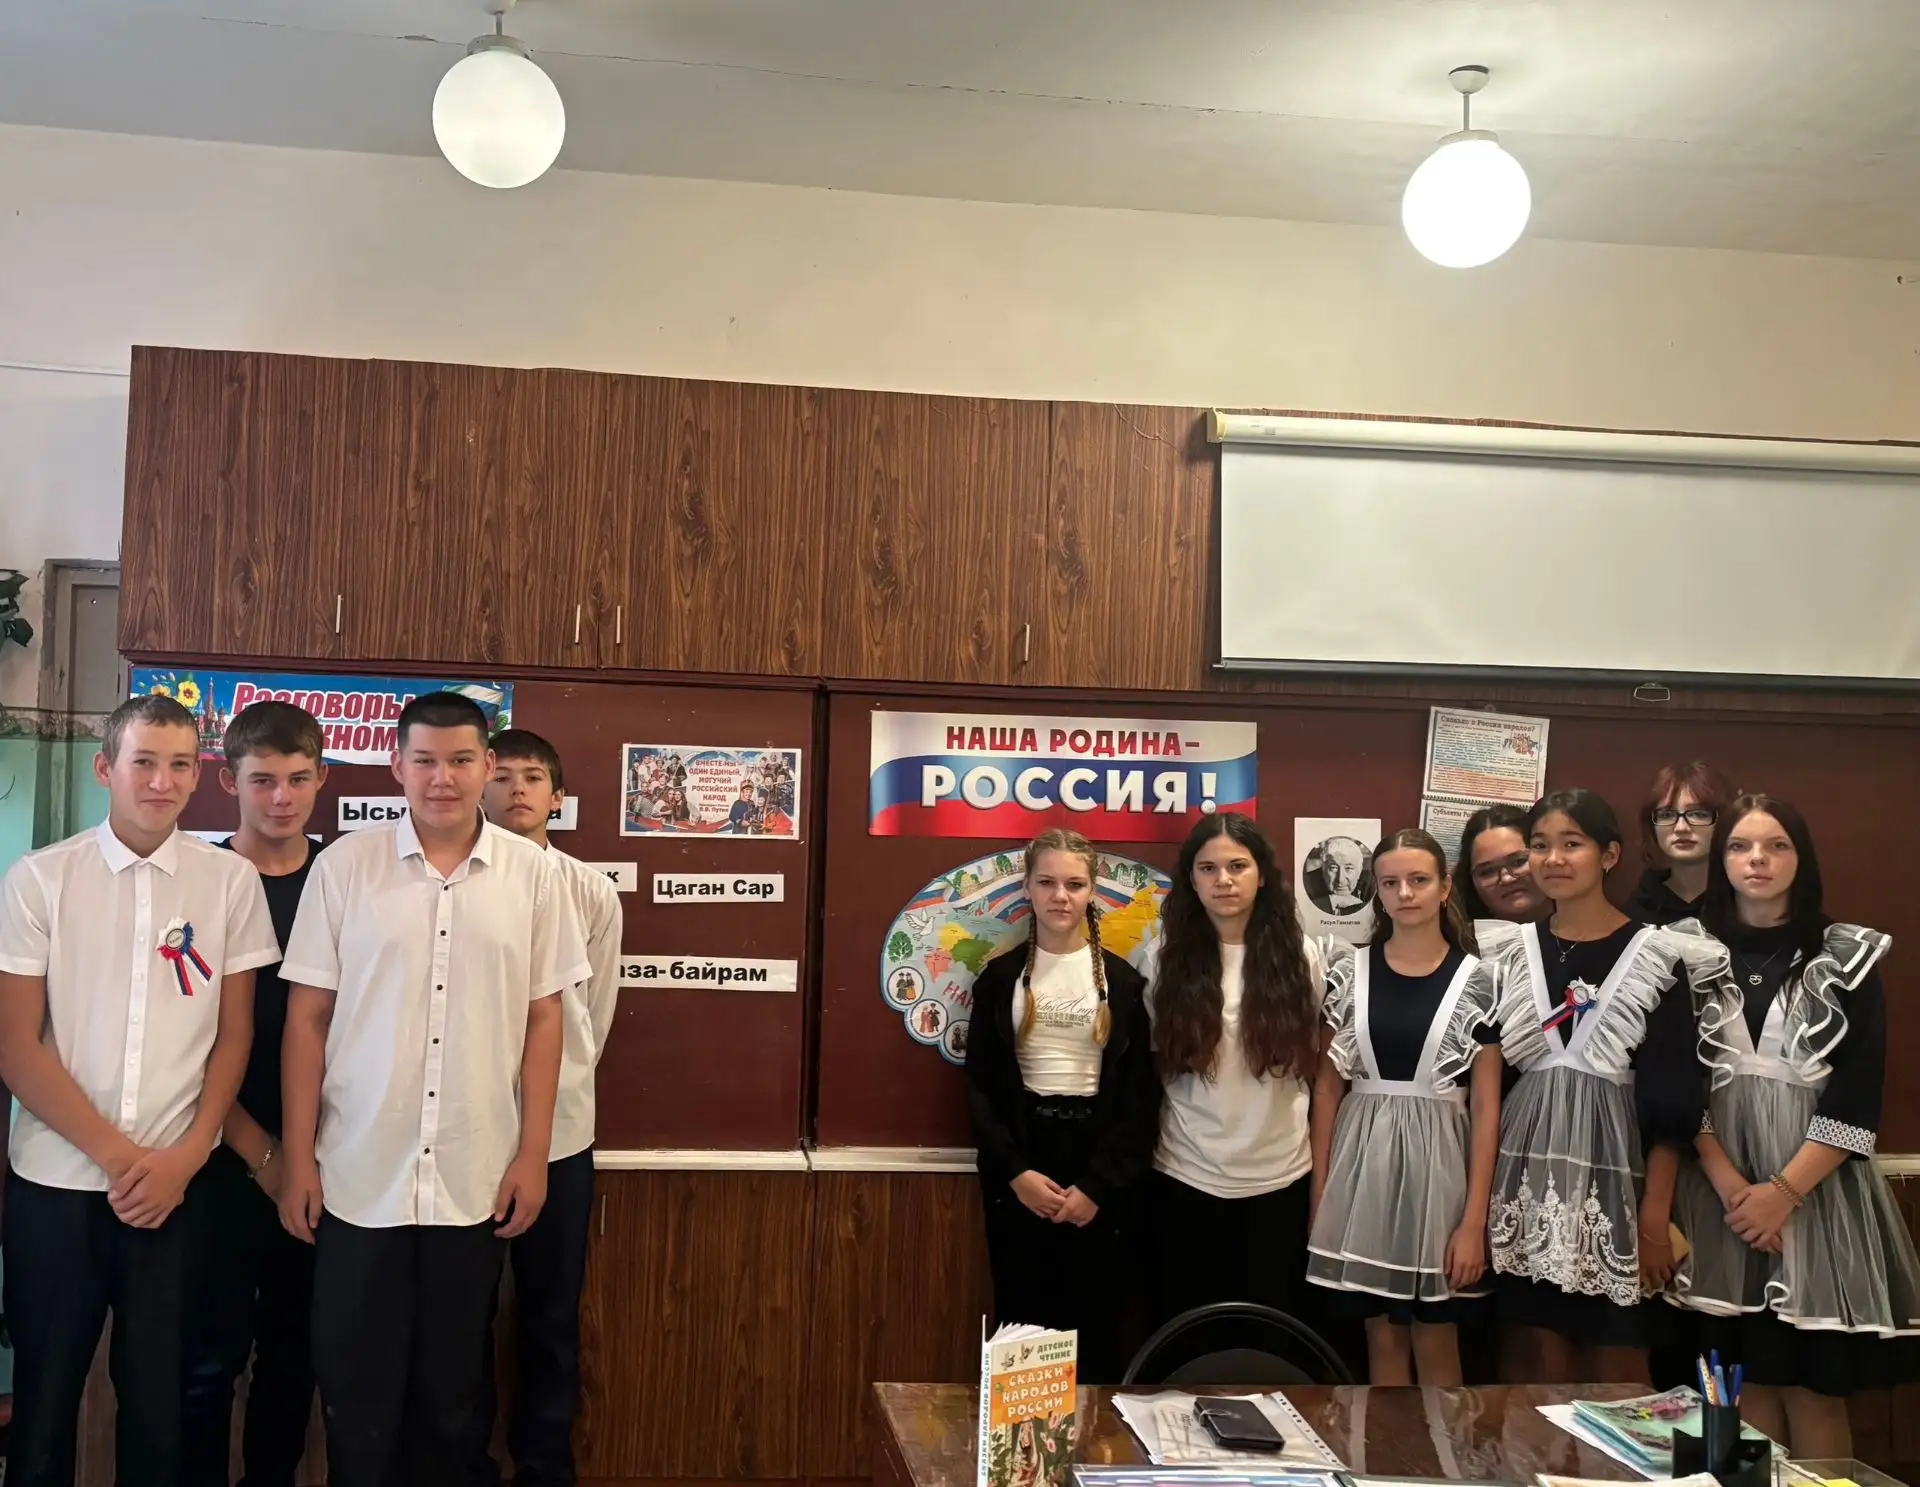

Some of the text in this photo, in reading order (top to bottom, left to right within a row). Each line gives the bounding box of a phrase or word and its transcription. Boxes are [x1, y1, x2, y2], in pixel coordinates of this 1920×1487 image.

[946, 726, 1039, 751] НАША
[691, 785, 738, 793] РОССИЙСКИЙ
[699, 776, 732, 784] МОГУЧИЙ
[702, 794, 726, 802] НАРОД
[921, 765, 1219, 815] РОССИЯ!
[343, 803, 407, 820] Ысы
[657, 879, 775, 899] Цаган Сар
[1037, 1339, 1073, 1354] ДЕТСКОЕ
[1039, 1350, 1071, 1362] ЧТЕНИЕ
[1009, 1367, 1064, 1387] СКАЗКИ
[1003, 1380, 1069, 1404] НАРОДОВ
[1007, 1397, 1064, 1418] РОССИИ
